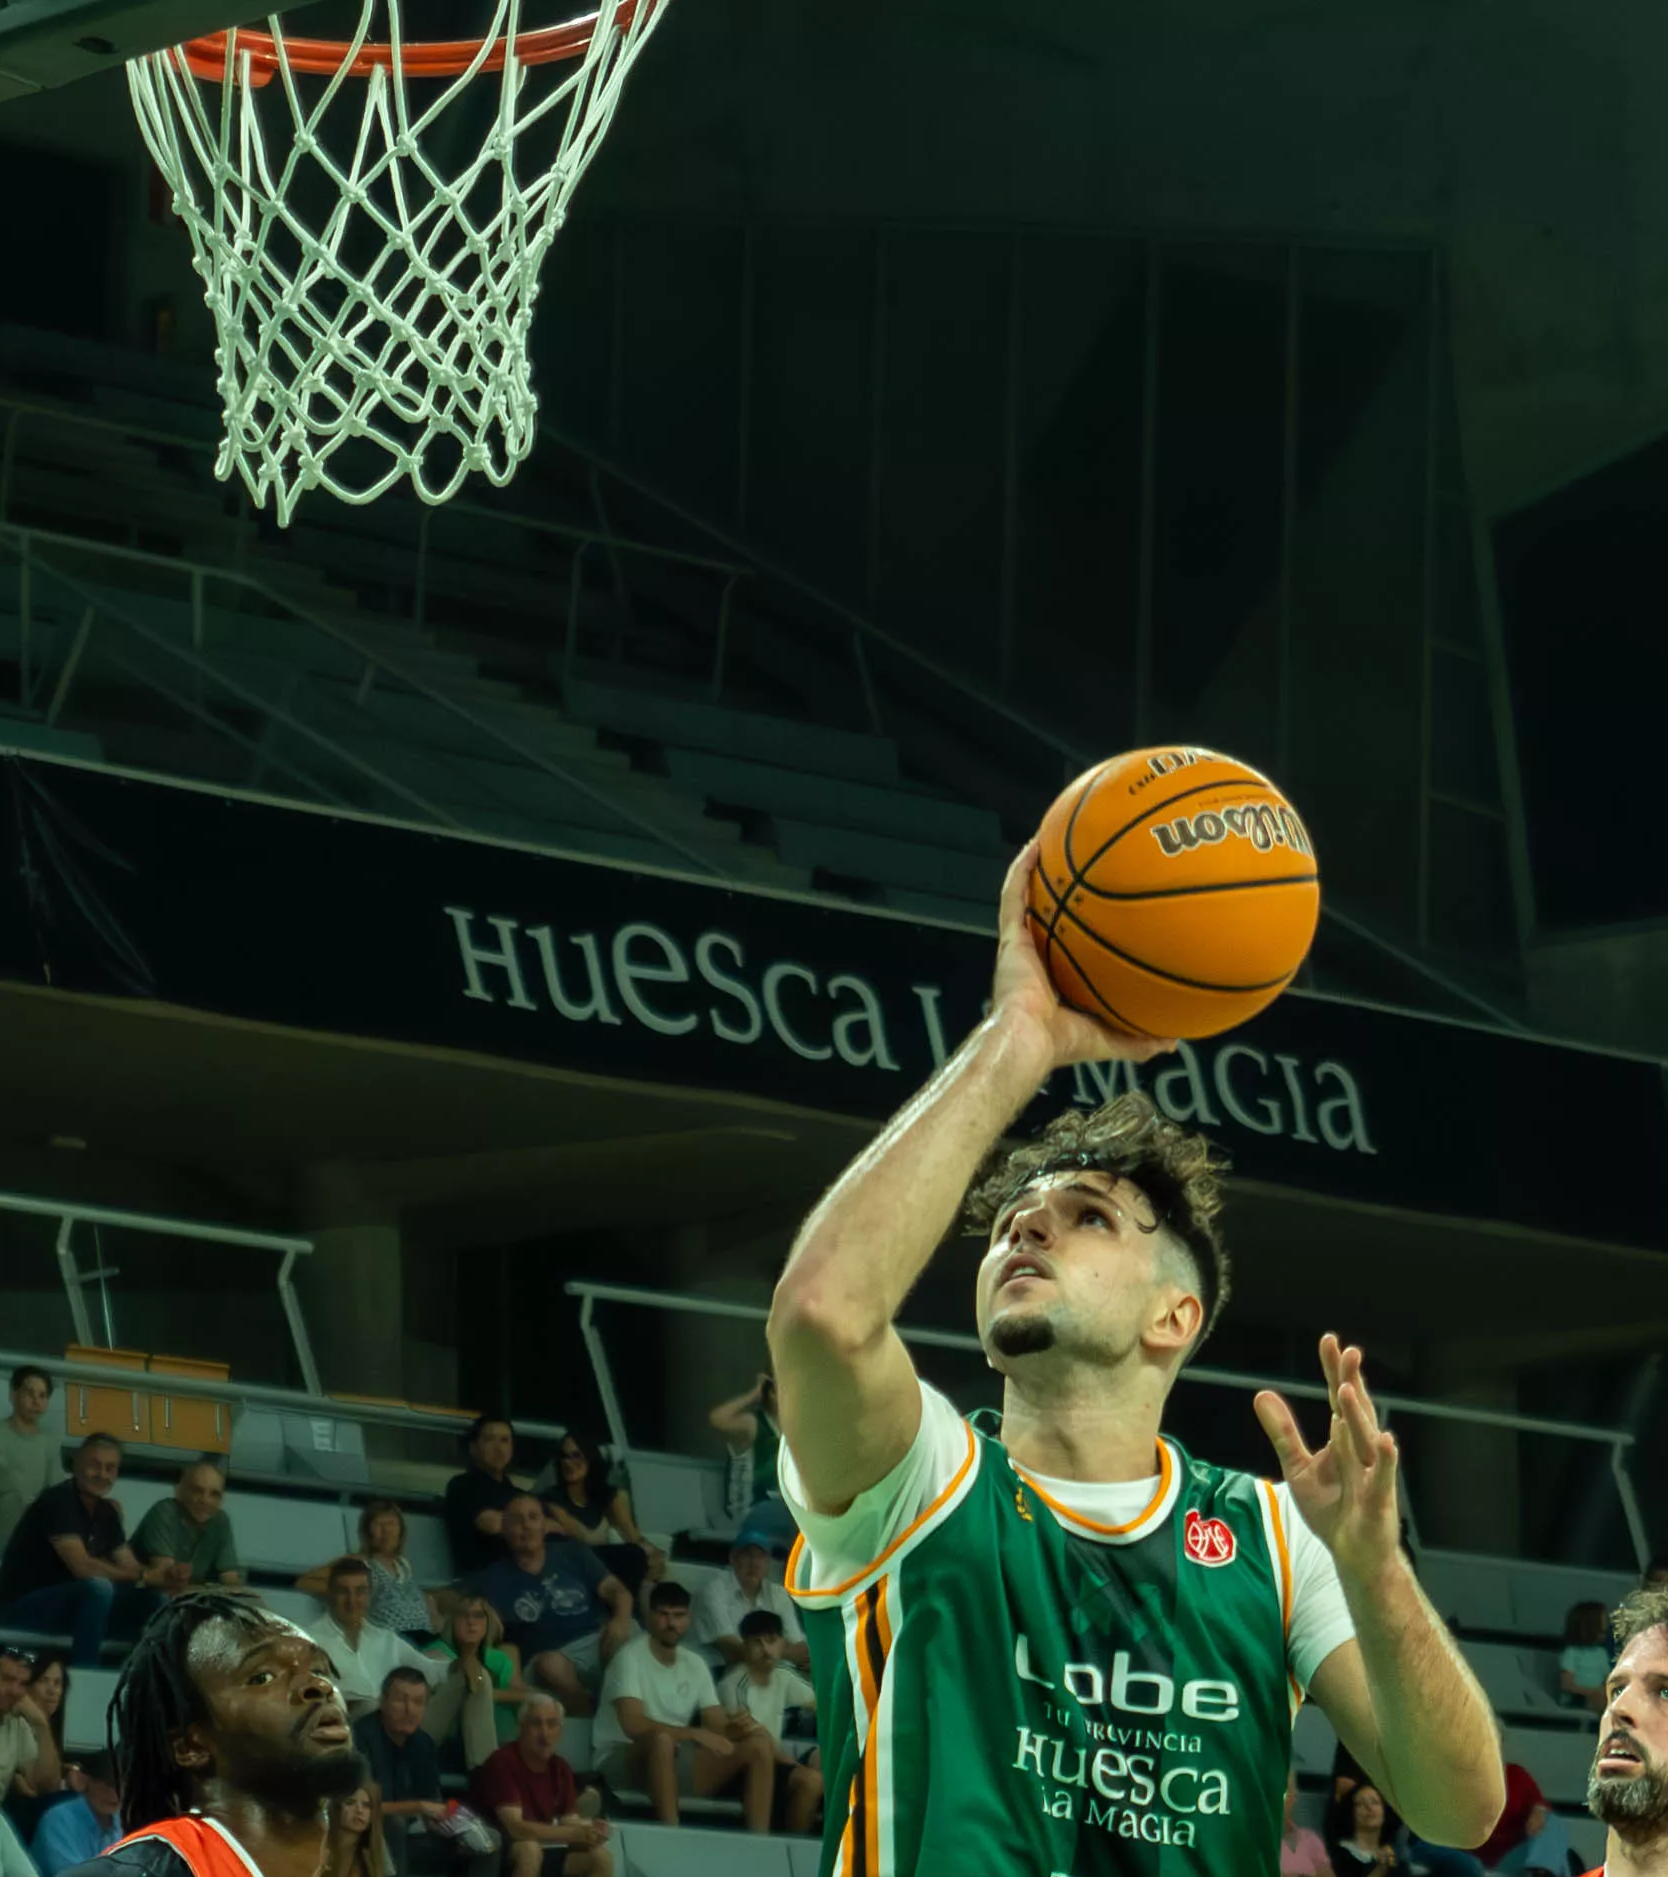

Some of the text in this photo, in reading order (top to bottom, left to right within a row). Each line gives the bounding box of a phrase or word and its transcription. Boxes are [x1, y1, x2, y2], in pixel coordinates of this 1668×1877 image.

[1150, 803, 1314, 858] Wilson
[444, 906, 901, 1072] Huesca
[1014, 1632, 1240, 1722] Lobe
[1012, 1725, 1231, 1816] Huesca
